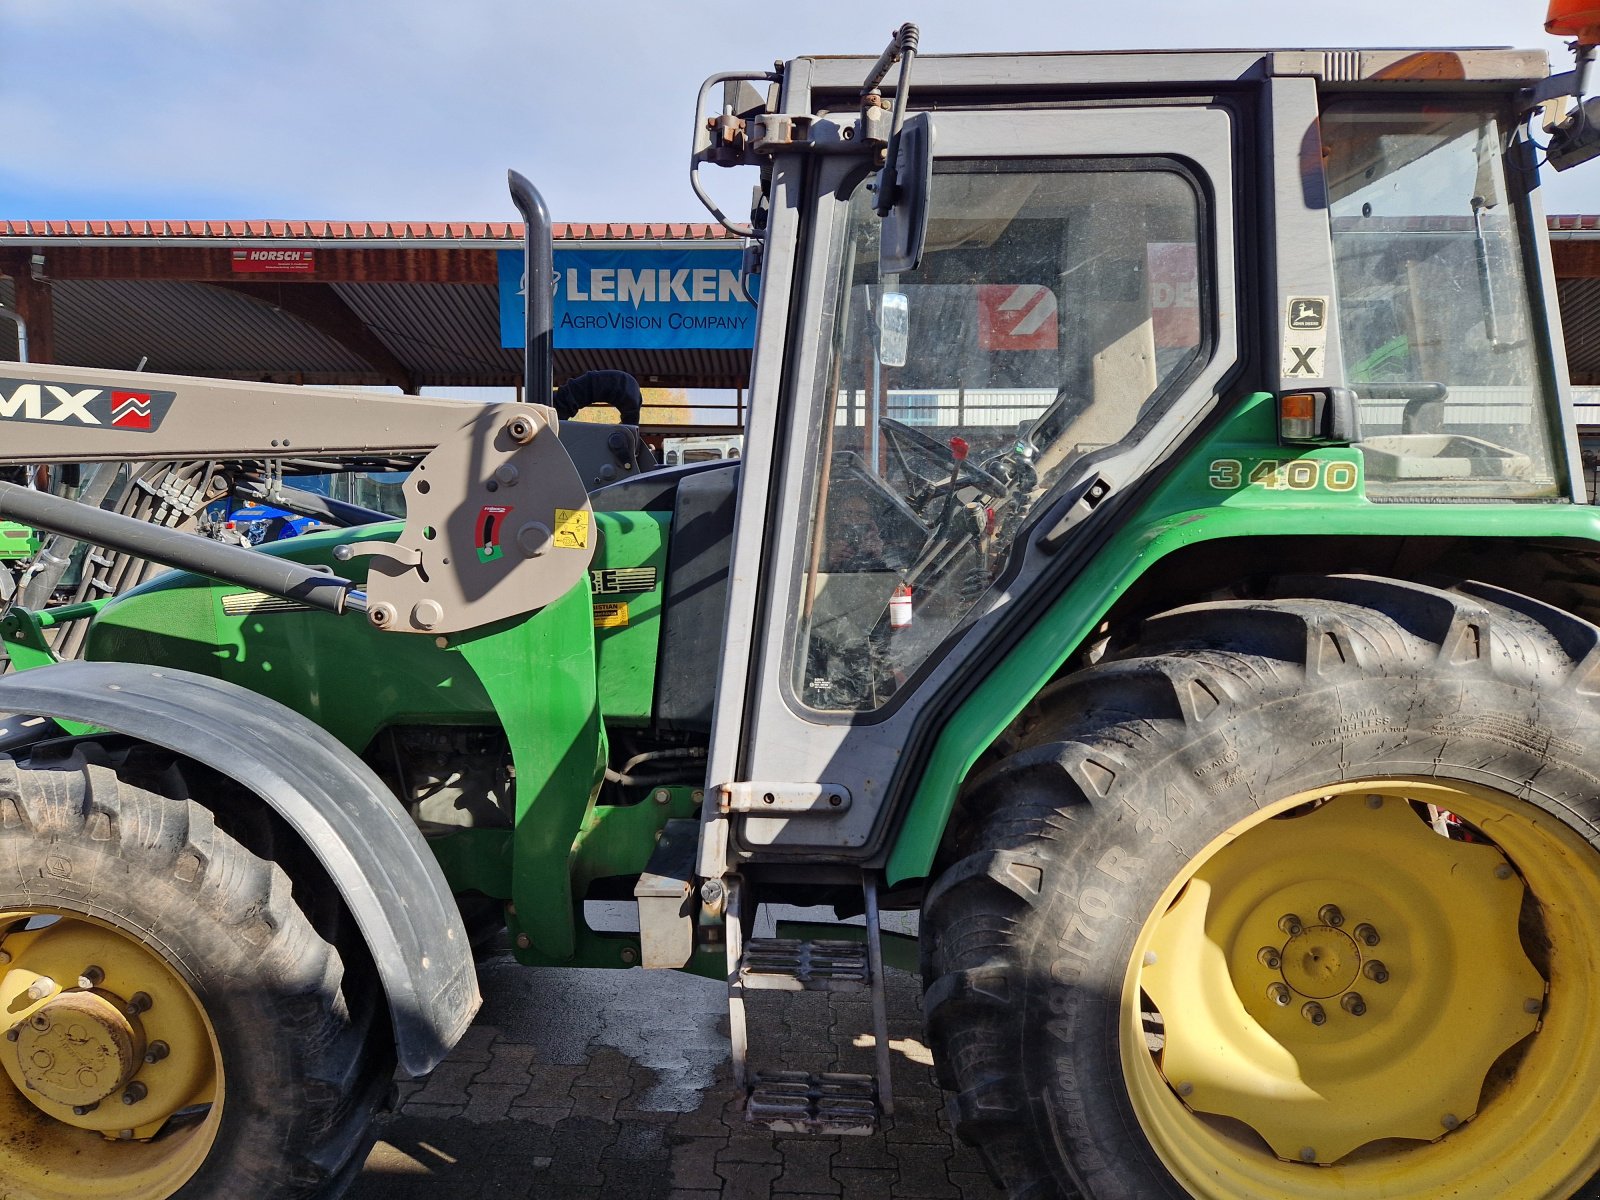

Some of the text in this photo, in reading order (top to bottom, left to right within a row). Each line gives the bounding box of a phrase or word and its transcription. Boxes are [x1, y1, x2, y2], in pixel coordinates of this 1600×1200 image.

[250, 251, 301, 260] HORSCH
[566, 268, 749, 310] LEMKEN
[1290, 347, 1317, 374] X
[0, 384, 104, 425] MX
[1209, 459, 1358, 492] 3400
